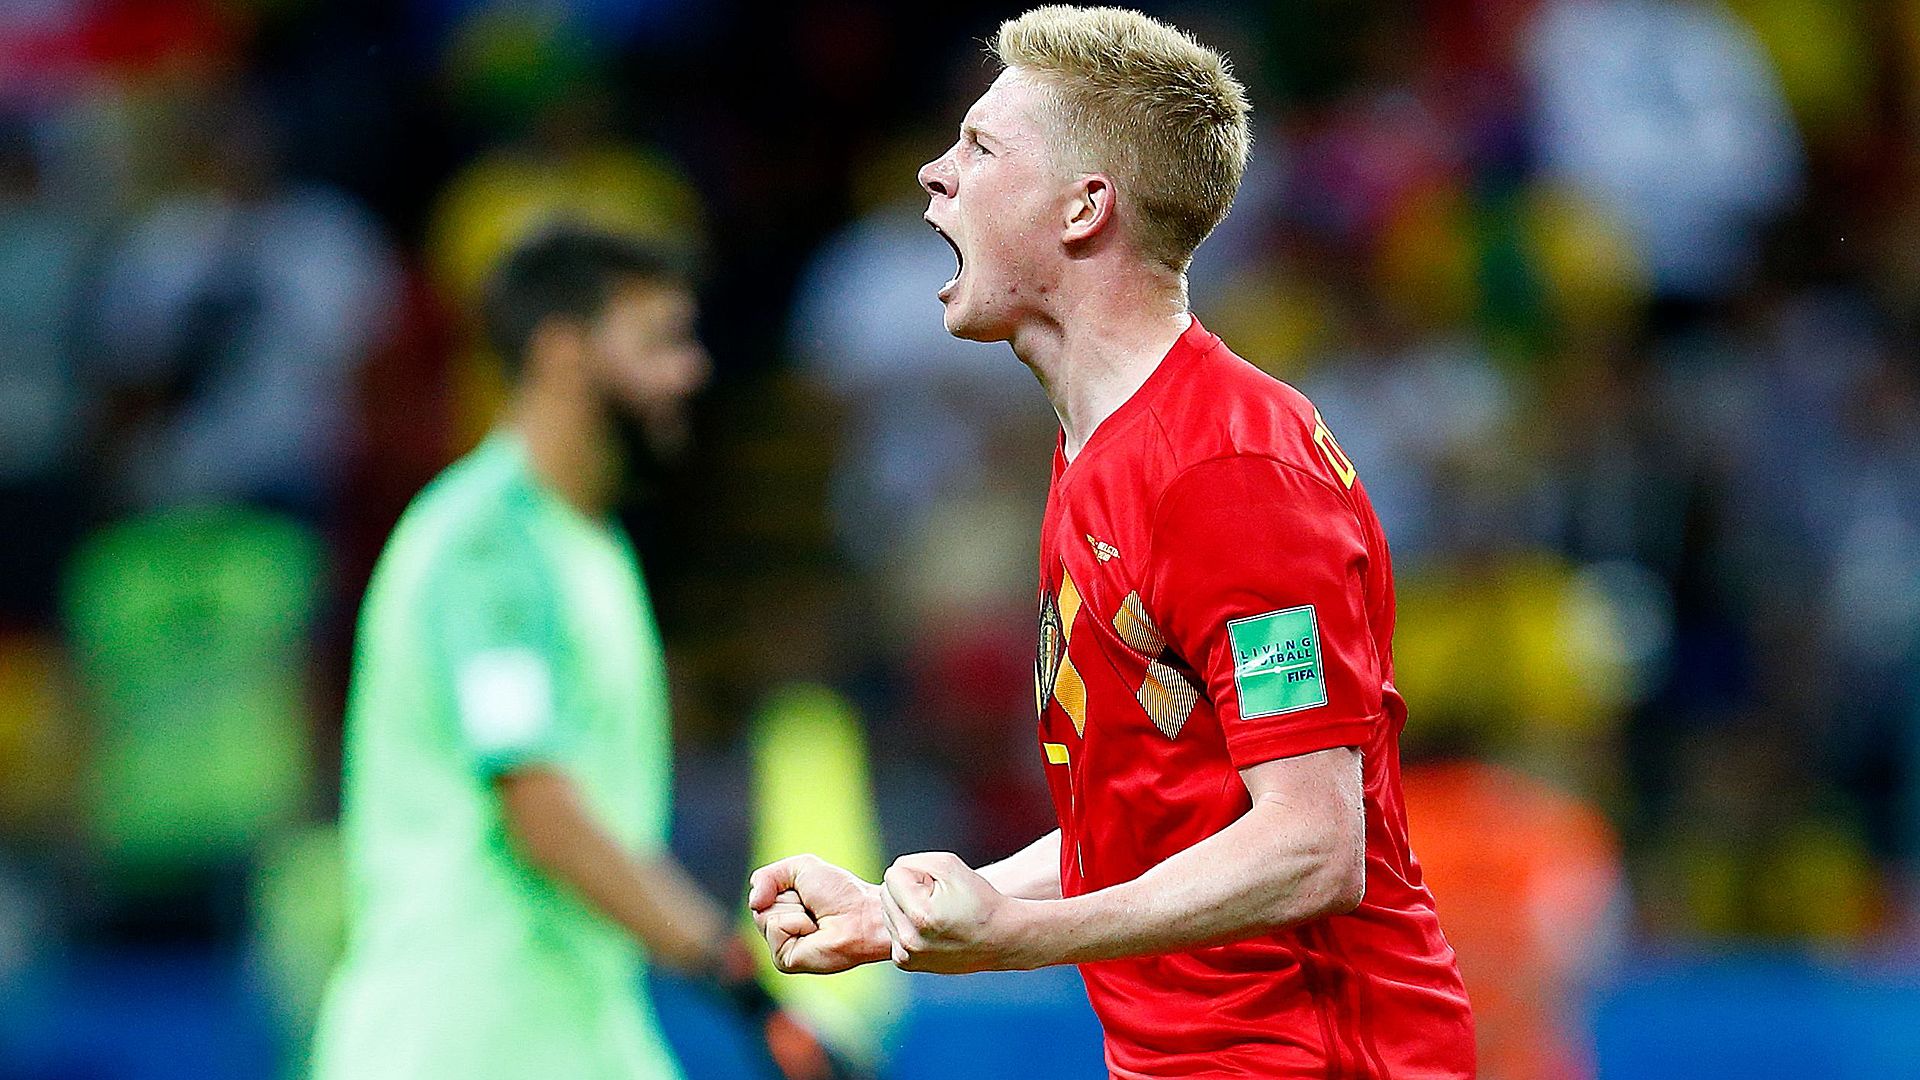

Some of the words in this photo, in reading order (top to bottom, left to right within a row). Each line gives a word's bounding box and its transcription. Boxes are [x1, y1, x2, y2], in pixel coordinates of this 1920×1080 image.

[1313, 407, 1357, 490] D
[1240, 637, 1311, 660] LIVING
[1242, 649, 1312, 670] TBALL
[1287, 669, 1315, 683] FIFA
